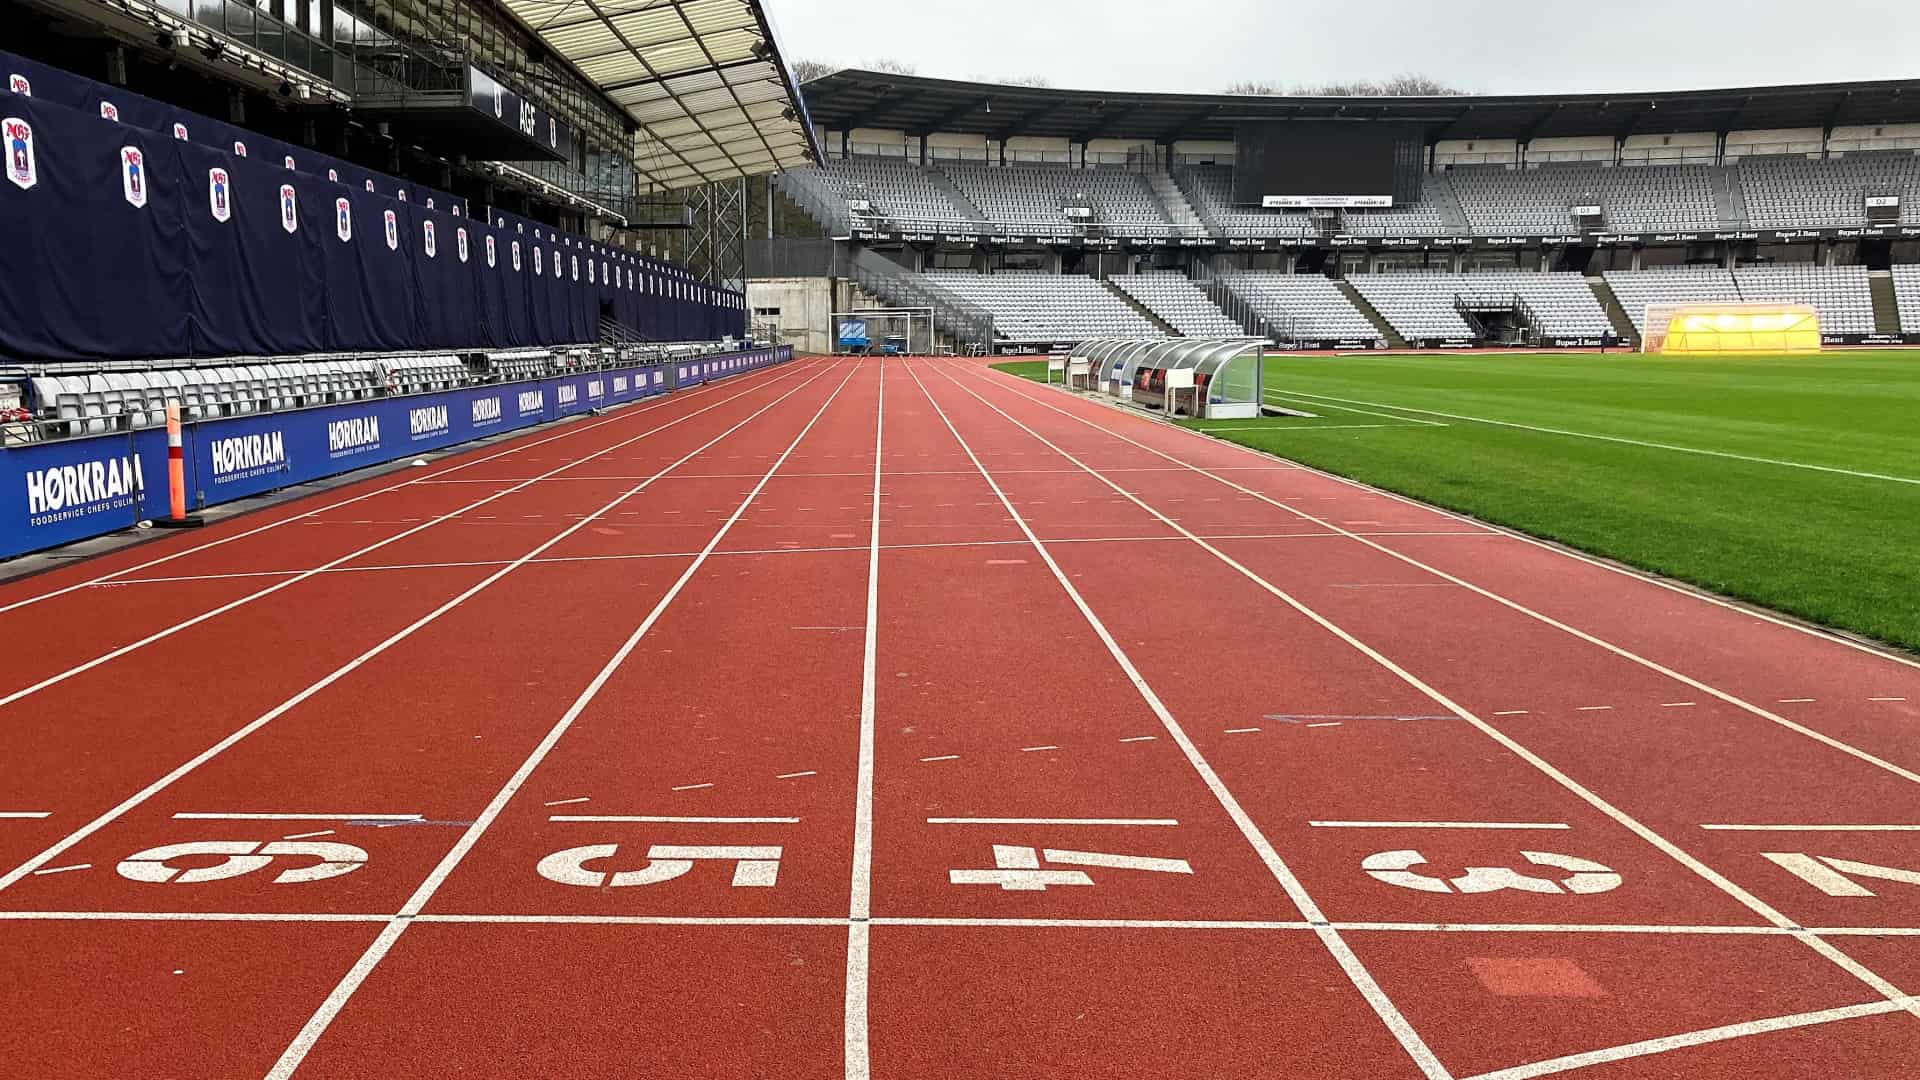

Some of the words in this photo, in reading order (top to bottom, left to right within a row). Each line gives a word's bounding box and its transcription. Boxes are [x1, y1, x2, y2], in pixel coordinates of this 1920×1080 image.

[520, 98, 535, 137] AGF
[328, 416, 379, 451] HØRKRAM
[409, 405, 449, 434] HØRKRAM
[211, 431, 285, 475] HØRKRAM
[27, 453, 144, 514] HØRKRAM
[31, 508, 85, 527] FOODSERVICE
[87, 502, 110, 514] CHEFS
[117, 841, 369, 884] 6
[536, 843, 783, 888] 5
[949, 844, 1192, 892] 4
[1362, 849, 1623, 895] 3
